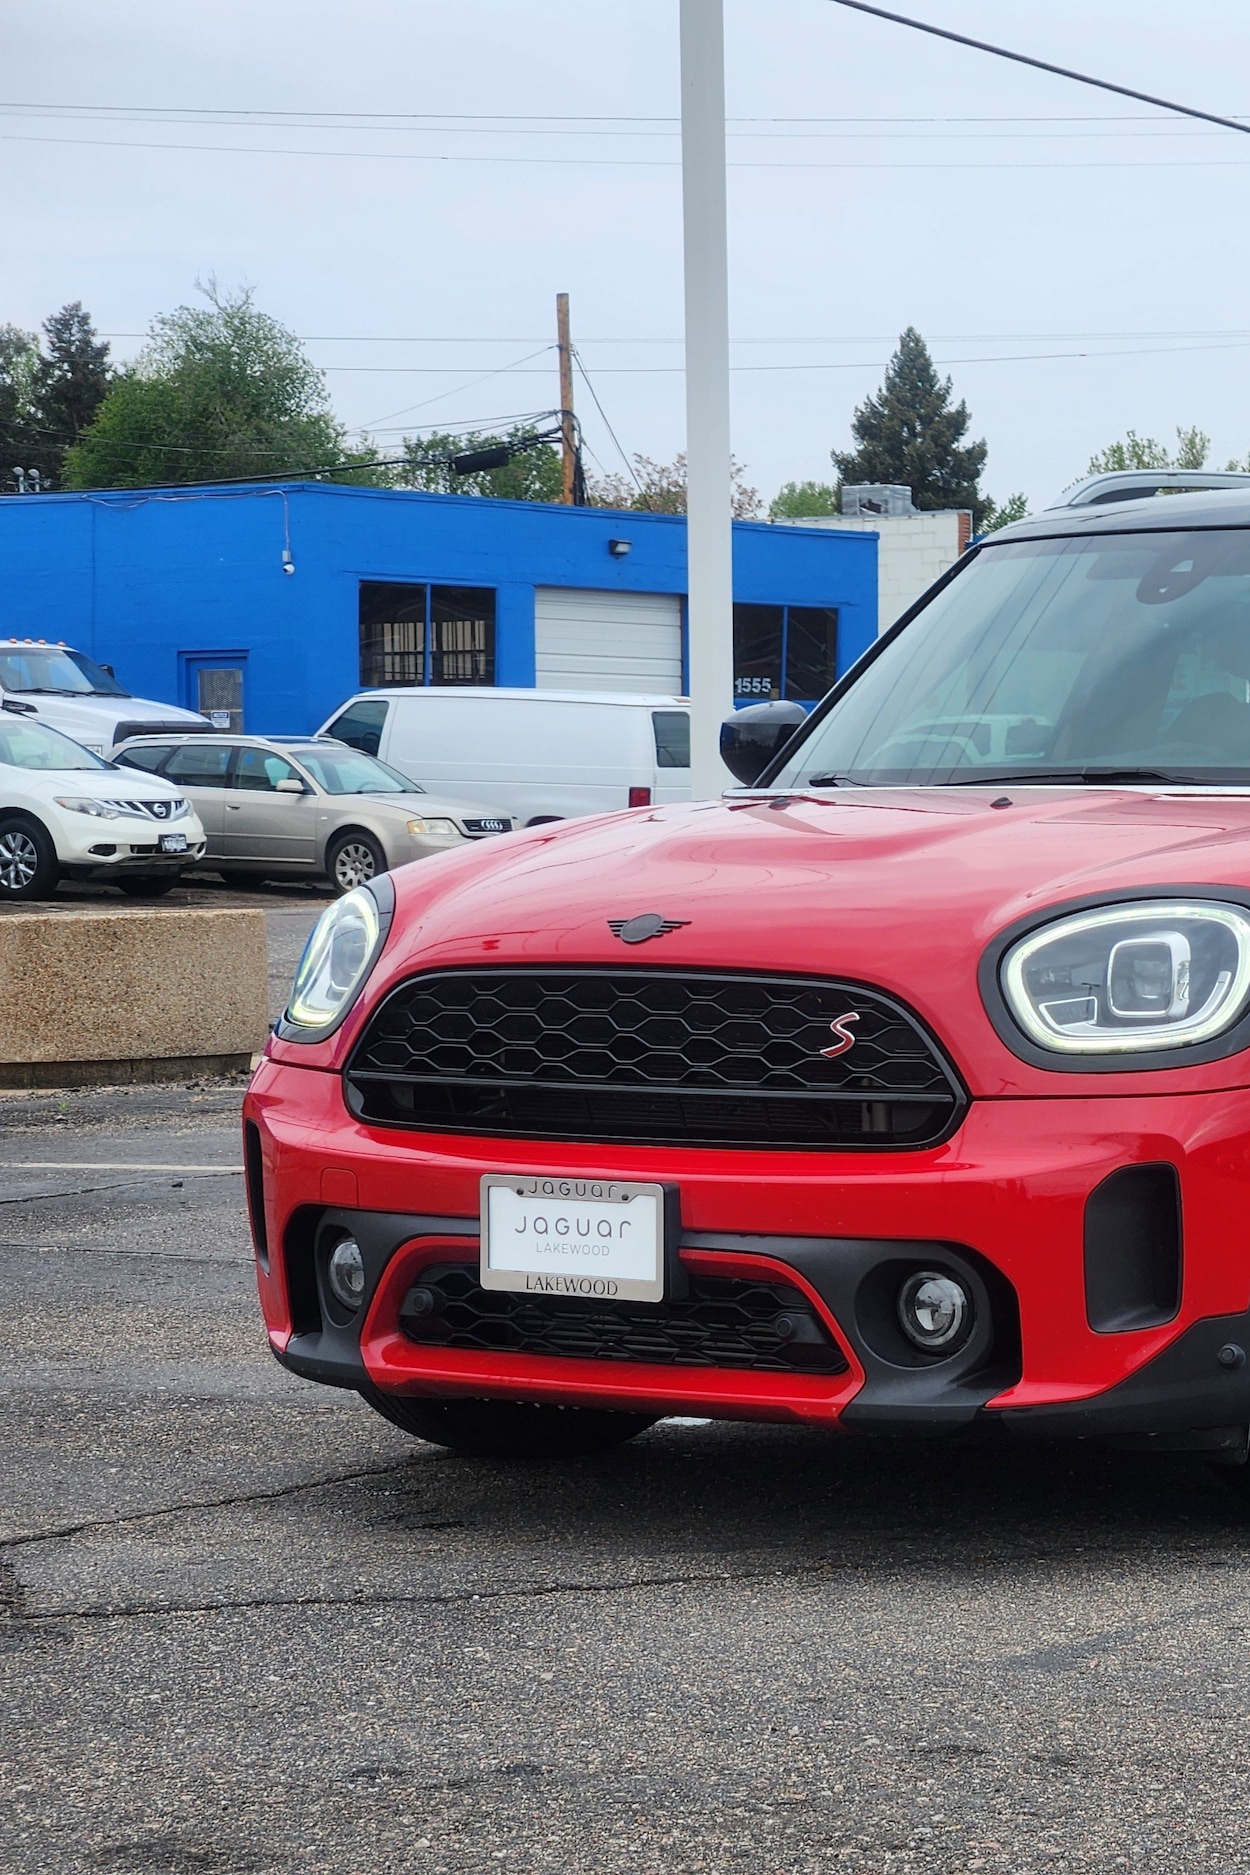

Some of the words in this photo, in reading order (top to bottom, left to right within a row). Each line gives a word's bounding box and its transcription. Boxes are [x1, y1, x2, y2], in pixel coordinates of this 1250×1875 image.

[735, 678, 771, 693] 1555
[820, 1011, 860, 1058] S
[536, 1242, 610, 1256] LAKEWOOD
[526, 1275, 618, 1296] LAKEWOOD
